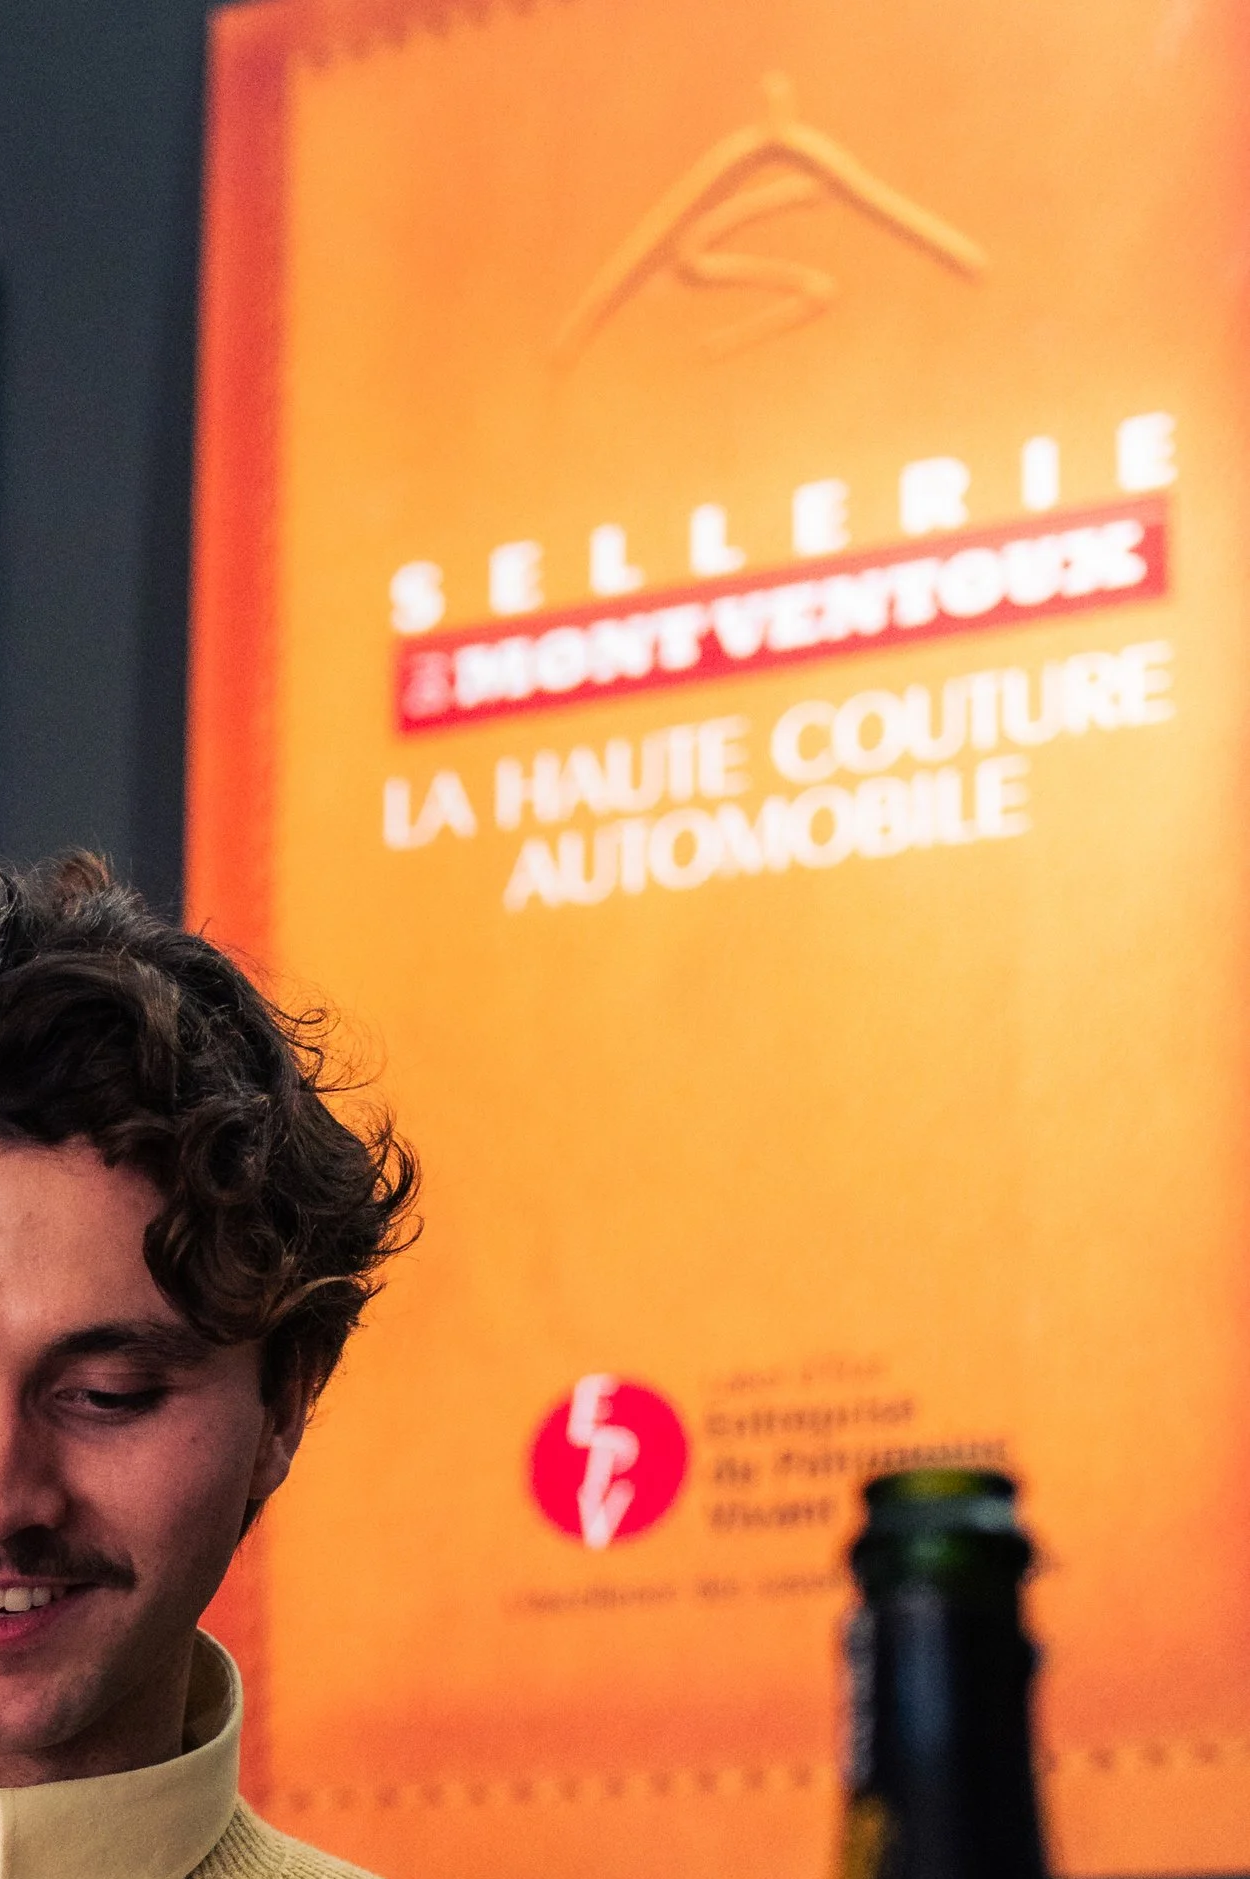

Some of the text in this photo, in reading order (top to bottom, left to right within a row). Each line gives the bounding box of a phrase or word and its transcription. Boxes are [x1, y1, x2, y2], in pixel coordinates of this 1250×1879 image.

[389, 412, 1176, 633] SELLERIE
[710, 519, 1146, 660] VENTOUX
[383, 642, 1176, 850] LA HAUTE COUTURE
[503, 756, 1031, 913] AUTOMOBILE
